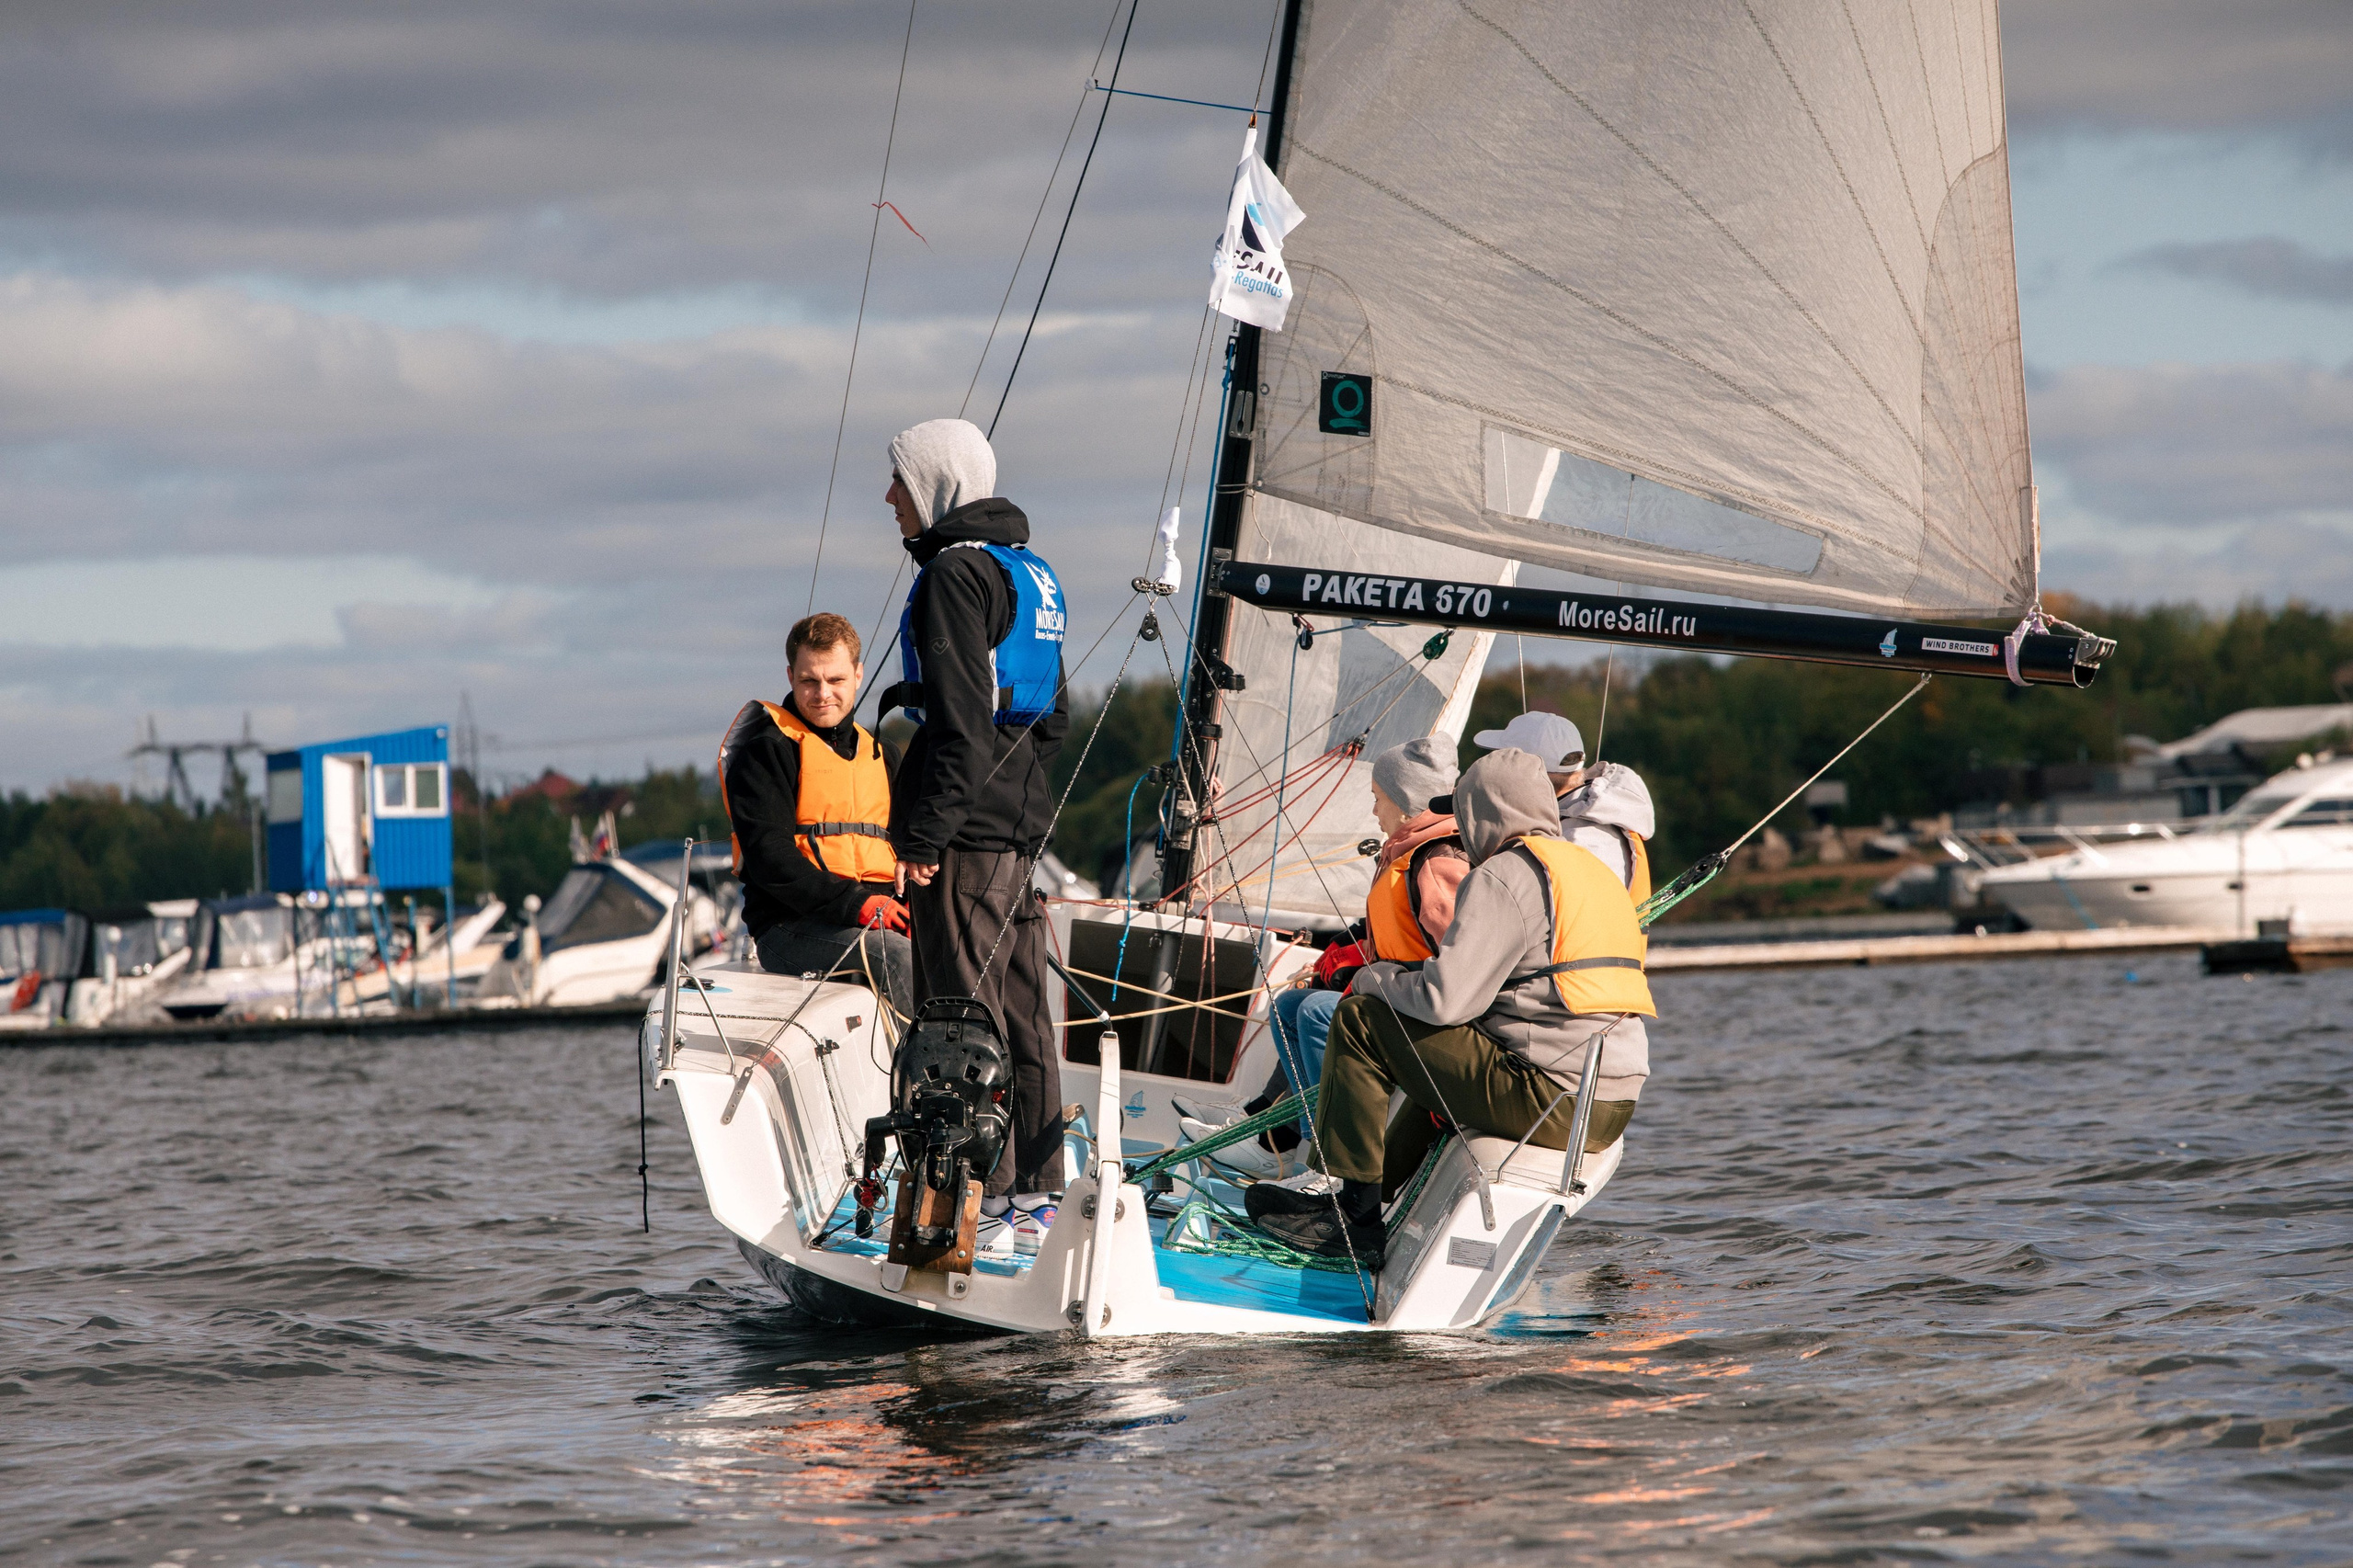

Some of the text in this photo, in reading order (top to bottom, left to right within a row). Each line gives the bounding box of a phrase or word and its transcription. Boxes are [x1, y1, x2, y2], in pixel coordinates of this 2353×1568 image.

[1233, 270, 1284, 299] Regattas
[1435, 585, 1492, 618] 670
[1558, 600, 1697, 637] MoreSail.ru
[1926, 640, 1990, 653] WIND BROTHERS
[980, 1244, 994, 1253] AIR
